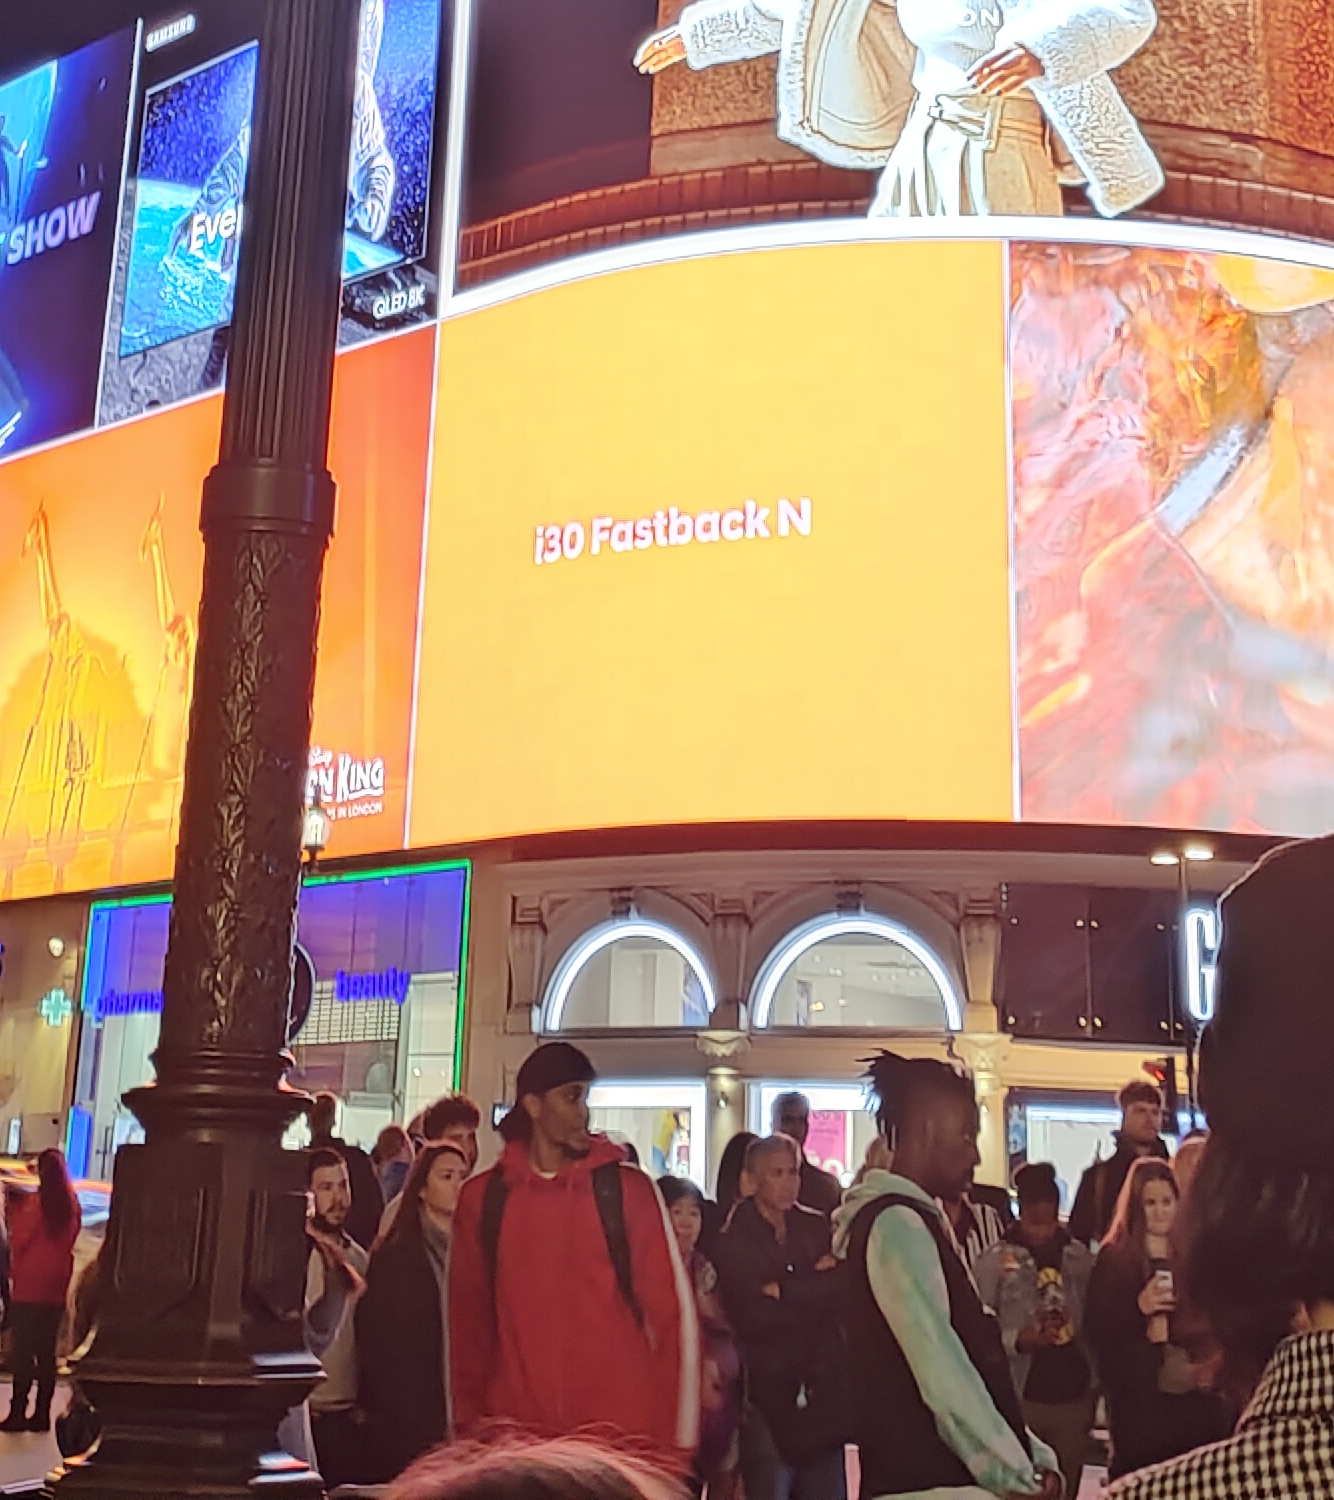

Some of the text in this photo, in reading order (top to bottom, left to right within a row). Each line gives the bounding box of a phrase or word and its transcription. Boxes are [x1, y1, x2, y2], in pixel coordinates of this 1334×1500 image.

[146, 14, 195, 52] SAMSUNG
[6, 190, 101, 266] SHOW
[373, 284, 426, 320] QLED 8K
[533, 496, 813, 565] i30 Fastback N
[348, 799, 383, 819] LONDON
[335, 966, 410, 1005] beauty
[95, 989, 164, 1024] pharma
